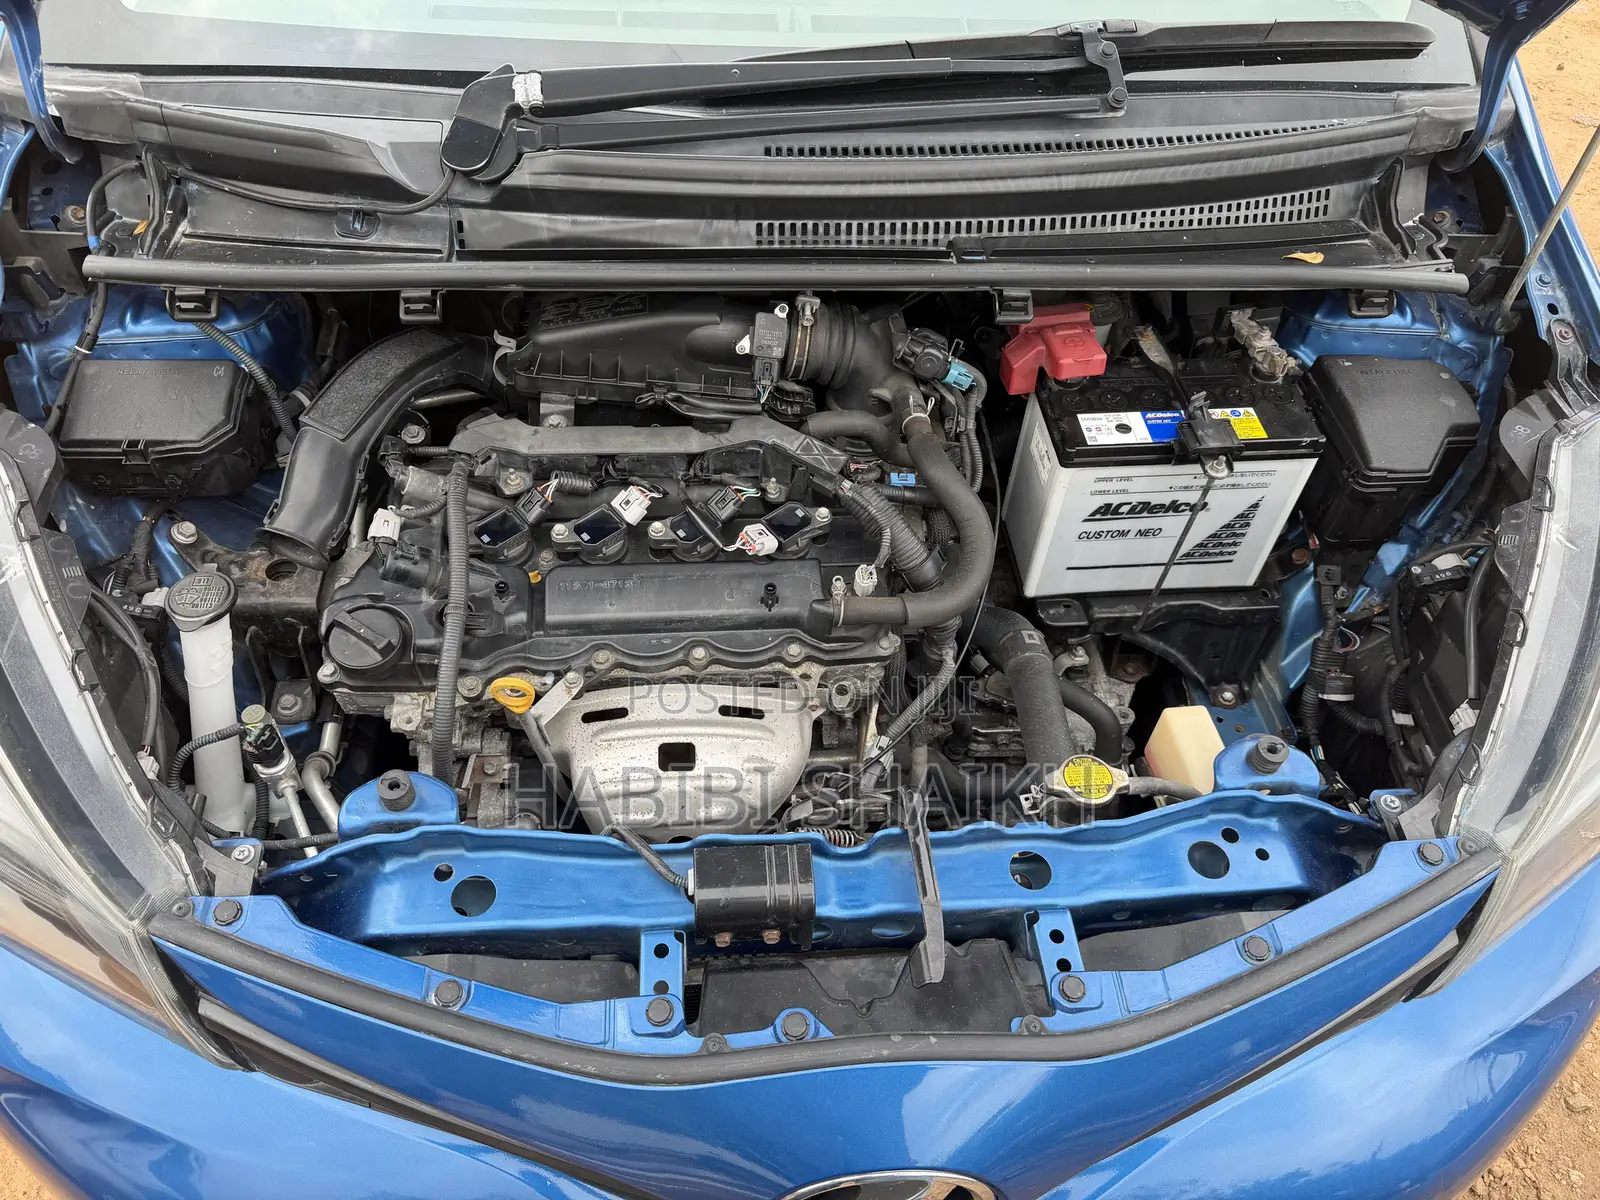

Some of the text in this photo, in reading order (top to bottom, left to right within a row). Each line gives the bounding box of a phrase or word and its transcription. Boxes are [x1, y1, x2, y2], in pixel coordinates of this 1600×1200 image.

[1077, 527, 1163, 540] CUSTOM NEO
[1179, 550, 1238, 559] ACDelco
